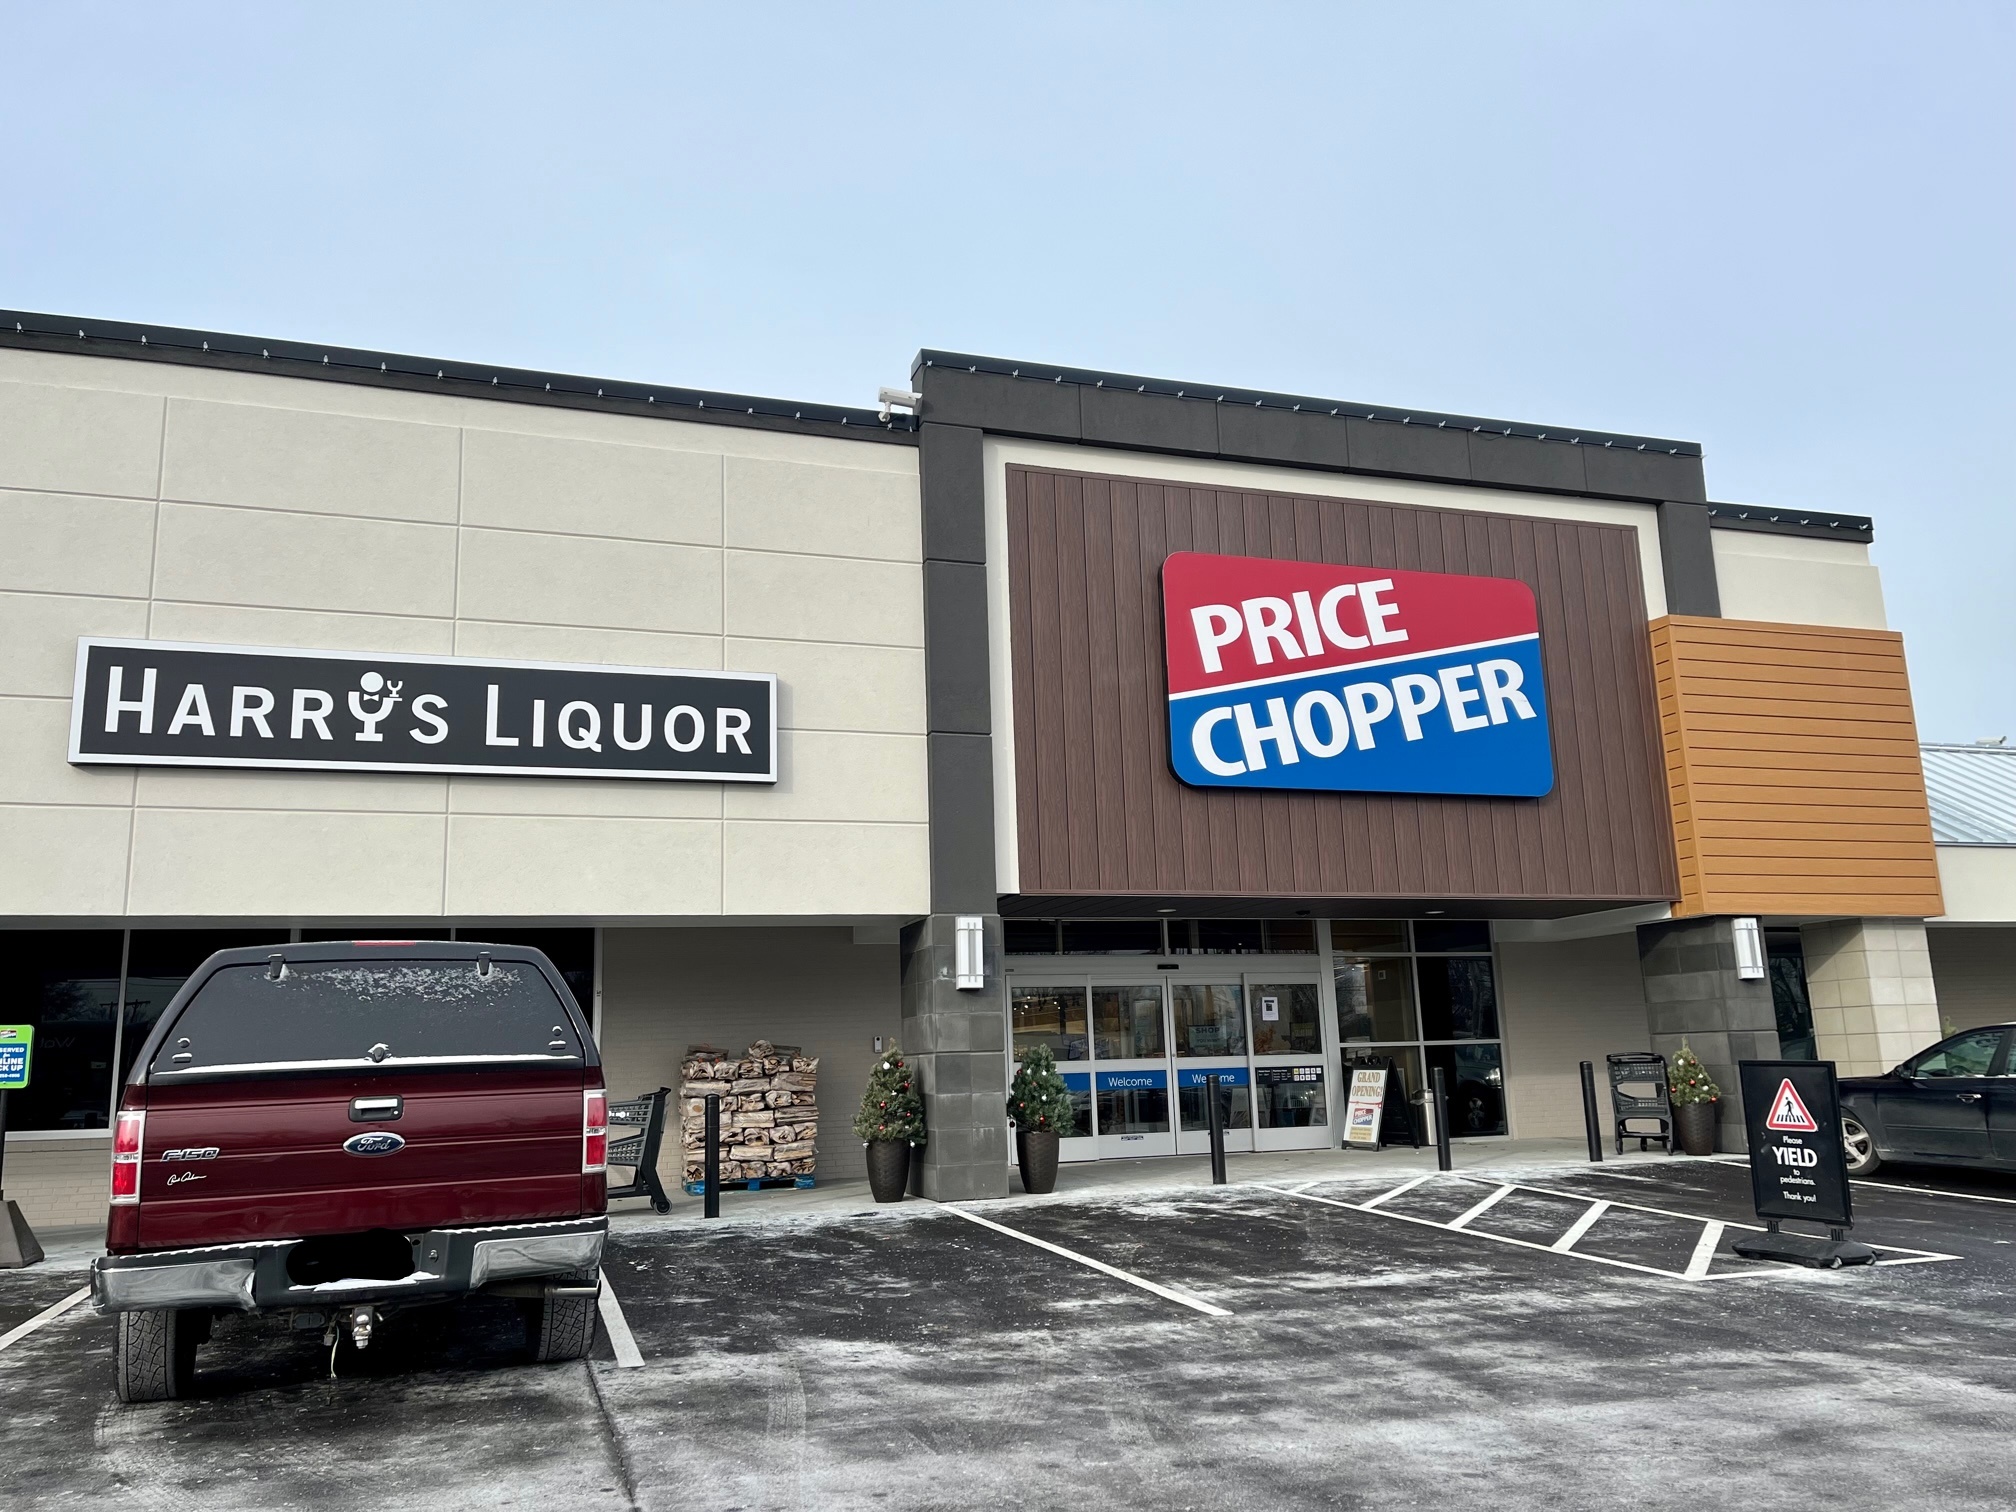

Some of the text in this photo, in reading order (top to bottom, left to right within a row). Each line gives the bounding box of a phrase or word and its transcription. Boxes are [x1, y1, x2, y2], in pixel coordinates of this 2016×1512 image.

[1190, 578, 1409, 673] PRICE
[485, 684, 752, 754] LIQUOR
[1192, 659, 1537, 776] CHOPPER
[1108, 1077, 1153, 1087] Welcome
[1192, 1074, 1235, 1083] Weme
[1357, 1072, 1381, 1083] GRAND
[1352, 1085, 1383, 1097] OPENING!
[357, 1136, 392, 1151] Ford
[1782, 1135, 1803, 1145] Please
[1771, 1145, 1818, 1167] YIELD
[1782, 1191, 1817, 1203] Thank you!
